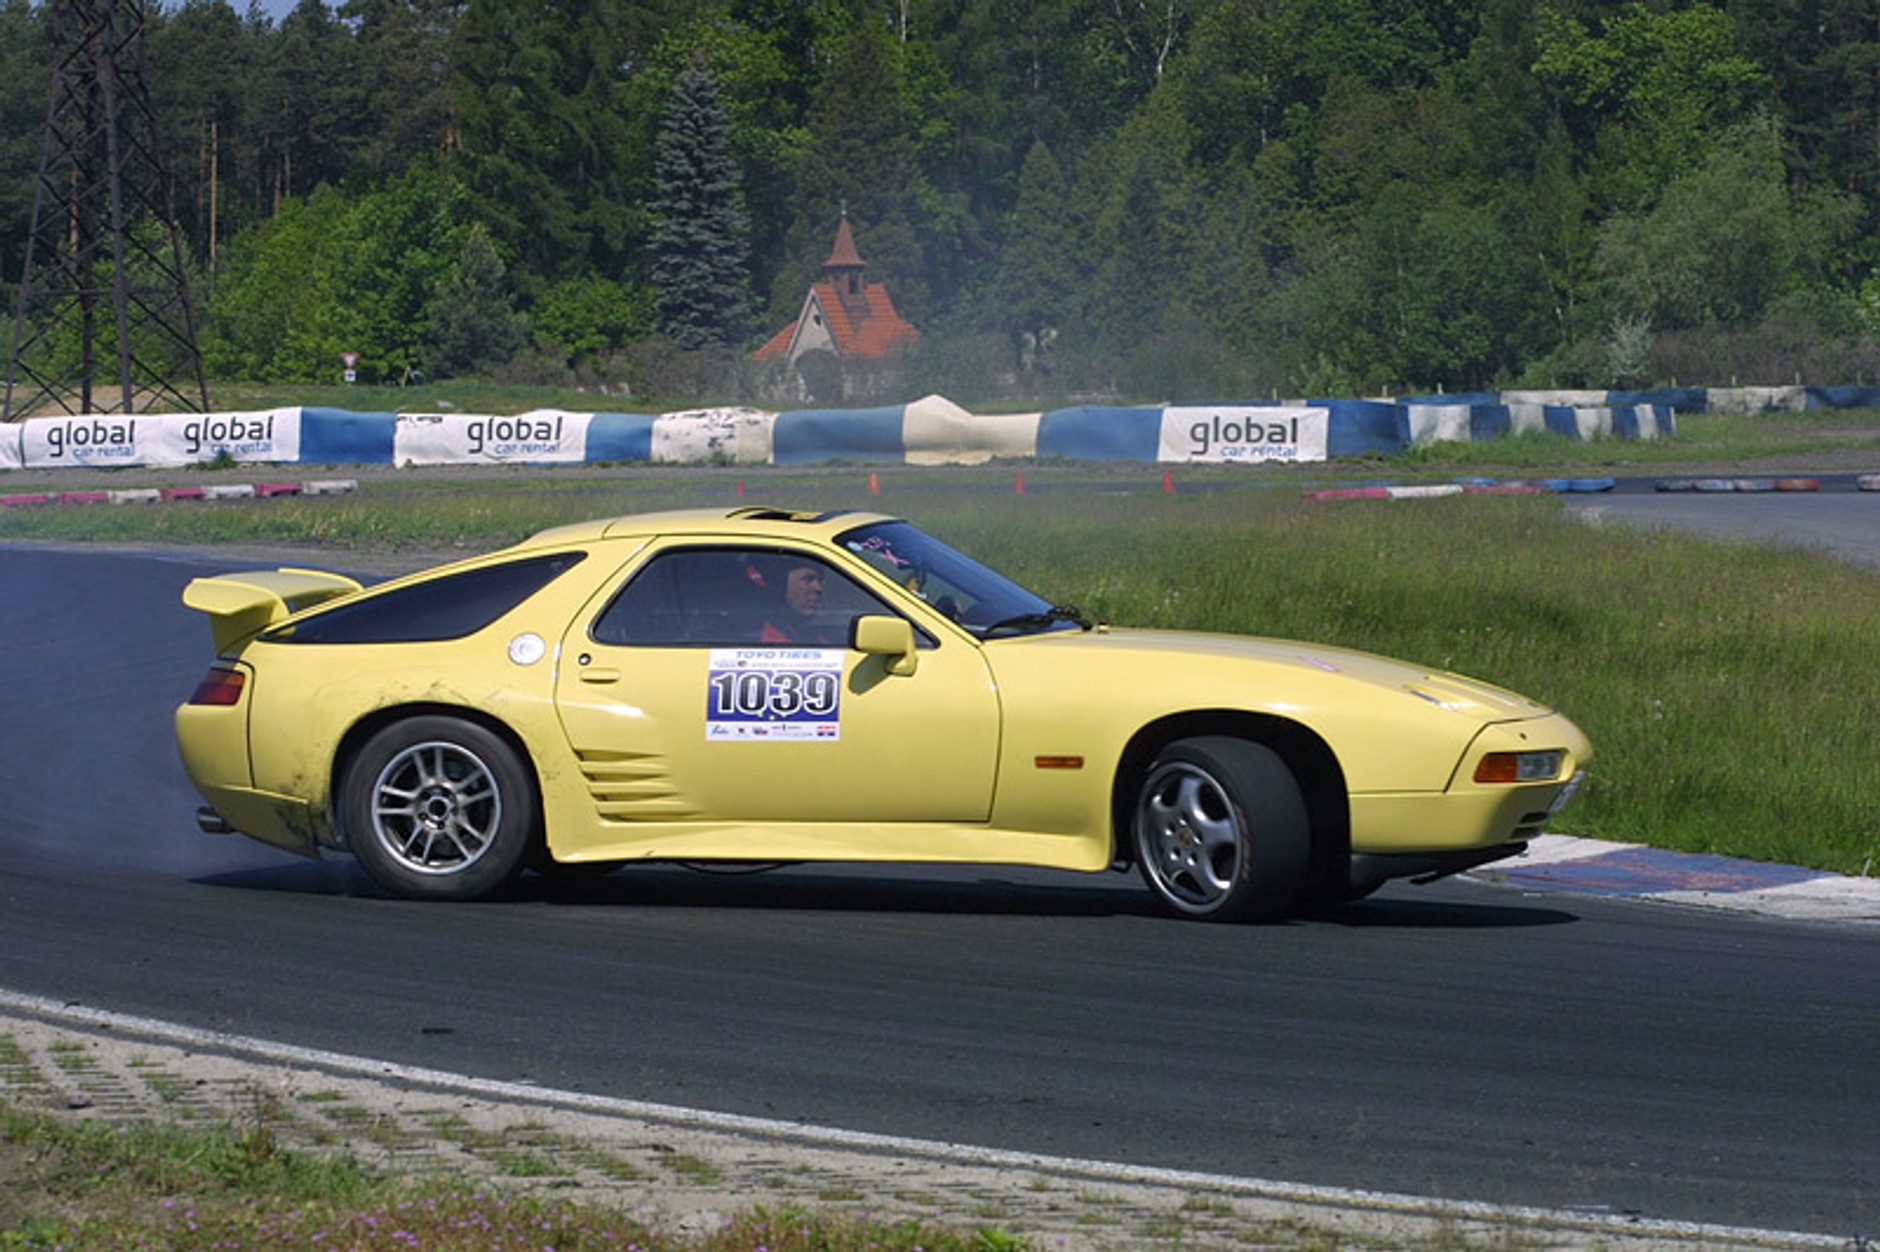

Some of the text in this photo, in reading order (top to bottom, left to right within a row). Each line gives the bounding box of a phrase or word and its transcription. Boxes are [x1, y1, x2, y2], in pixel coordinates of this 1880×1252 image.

[47, 420, 135, 457] global
[73, 444, 134, 457] car rental
[184, 416, 274, 453] global
[467, 416, 563, 454] global
[494, 441, 561, 454] car rental
[1190, 416, 1298, 455] global
[1220, 445, 1297, 457] car rental
[735, 651, 821, 659] TOYO TIRES
[713, 672, 837, 713] 1039
